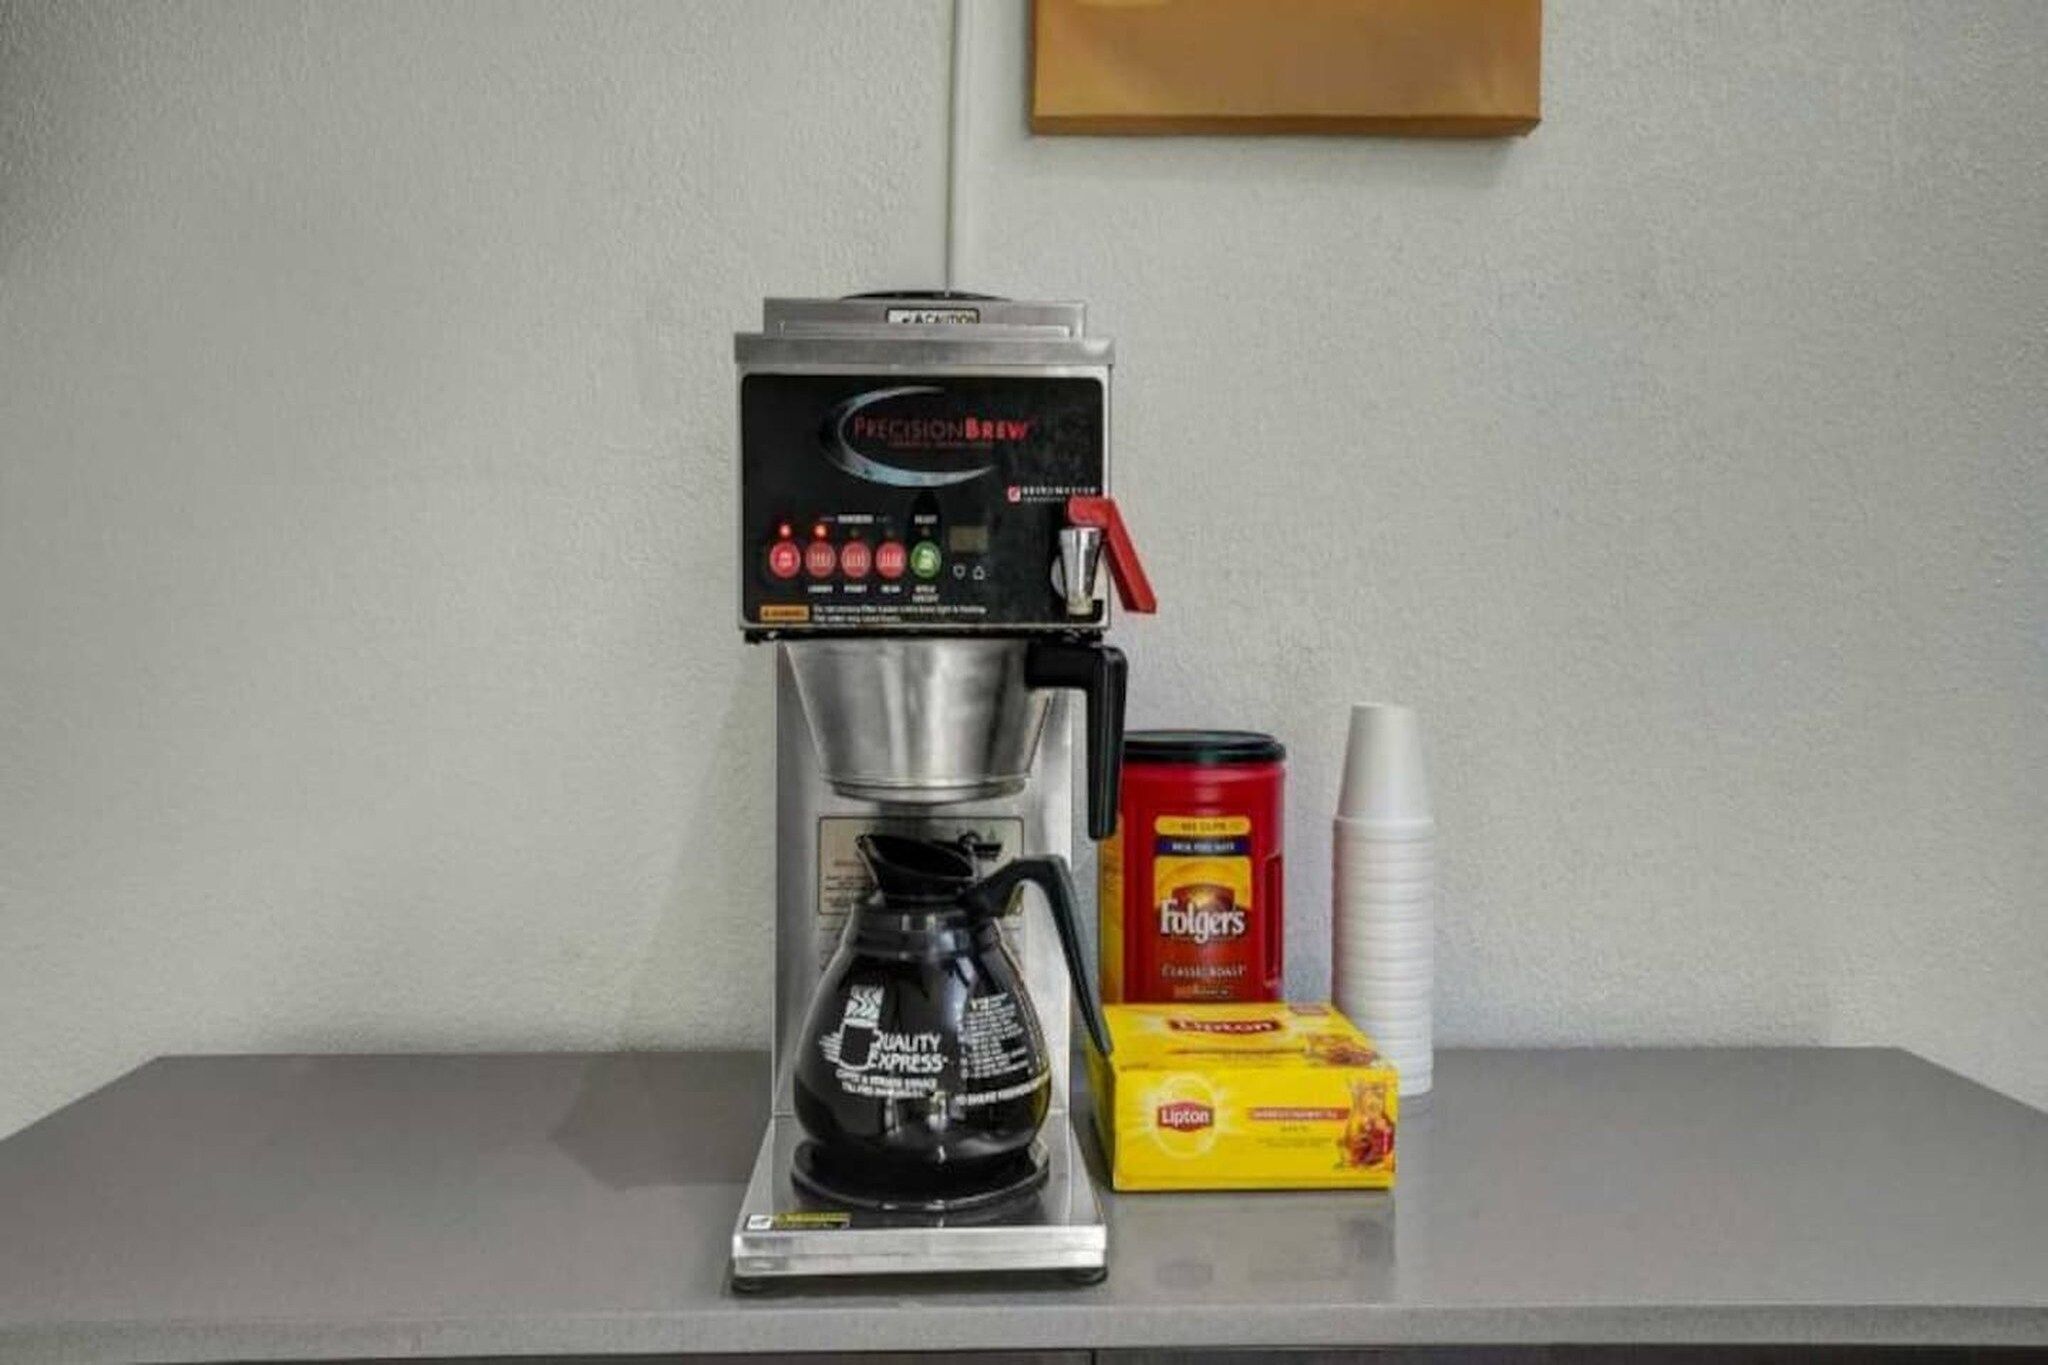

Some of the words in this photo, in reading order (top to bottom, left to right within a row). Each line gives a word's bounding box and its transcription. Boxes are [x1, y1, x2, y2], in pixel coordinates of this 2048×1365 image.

[1176, 1017, 1274, 1033] Lipton
[868, 1046, 944, 1074] EXPRESS
[1161, 1106, 1210, 1127] Lipton
